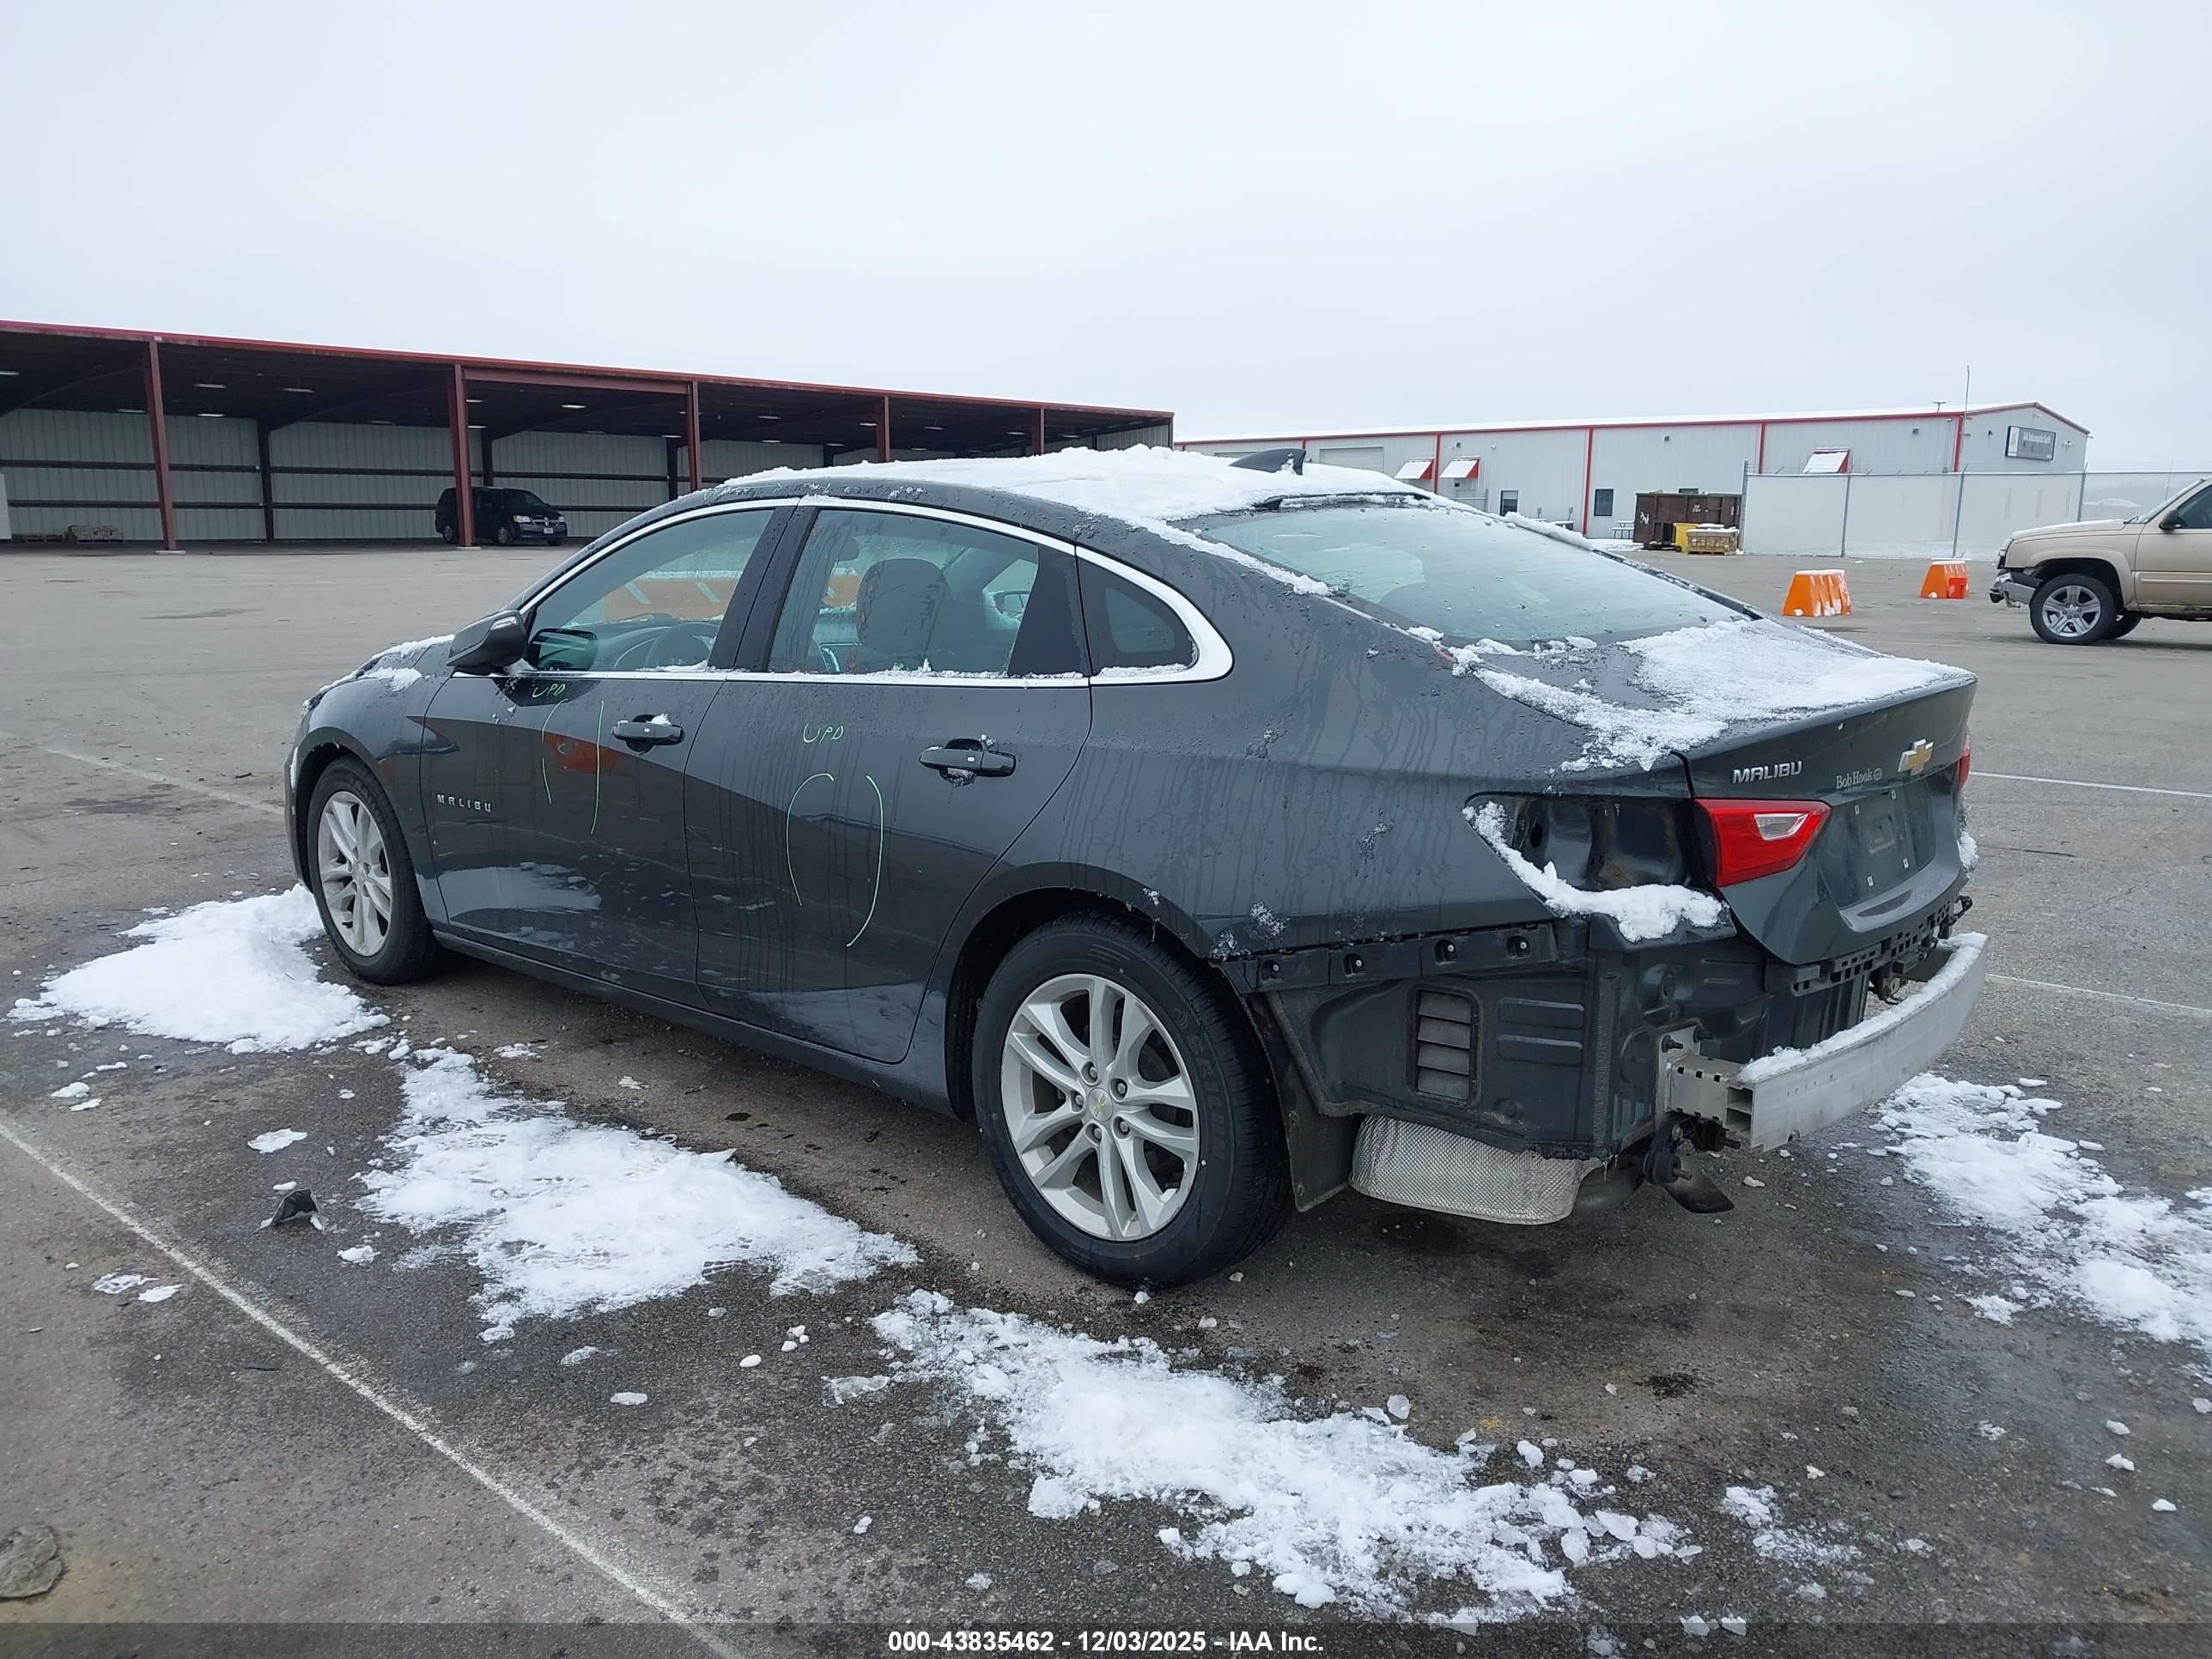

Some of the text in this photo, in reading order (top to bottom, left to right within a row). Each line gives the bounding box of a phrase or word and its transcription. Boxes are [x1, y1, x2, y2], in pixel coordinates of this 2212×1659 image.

[532, 683, 566, 698] UPD
[803, 723, 844, 744] UPD
[1732, 761, 1802, 783] MALIBU
[1835, 773, 1852, 789] Bob
[436, 793, 492, 812] MALIBU
